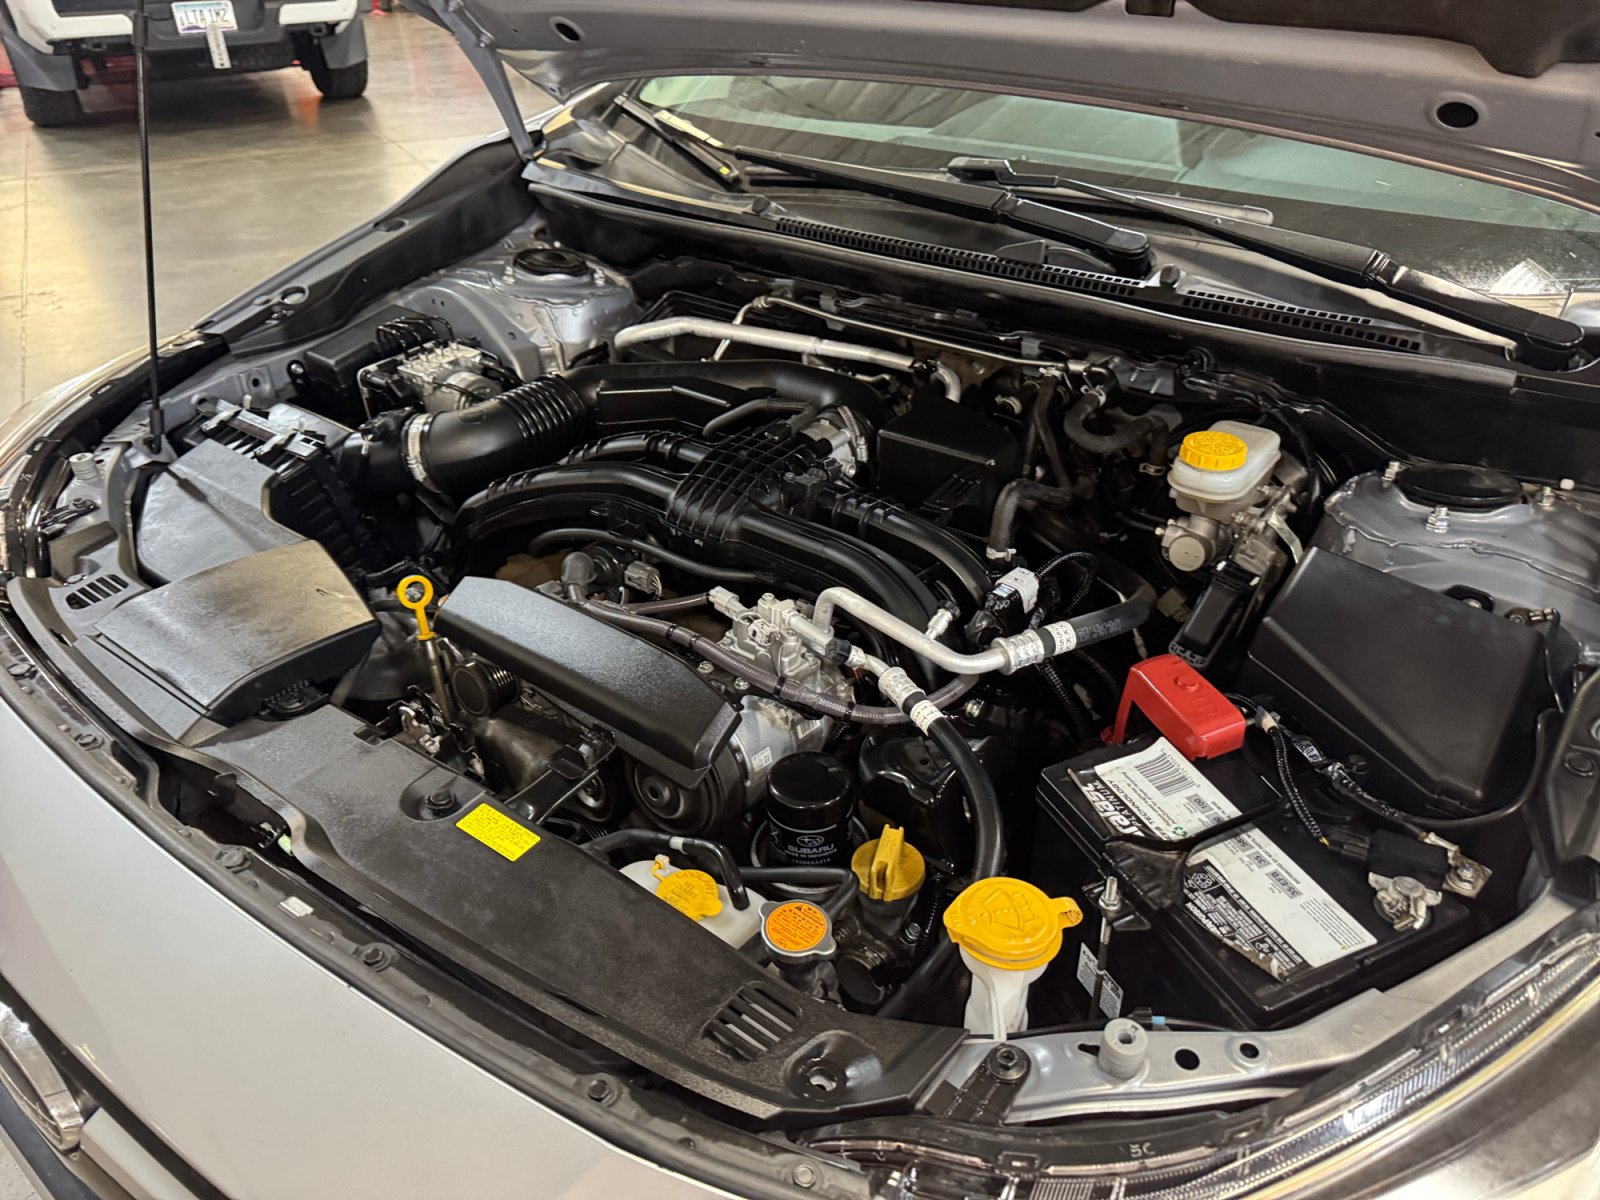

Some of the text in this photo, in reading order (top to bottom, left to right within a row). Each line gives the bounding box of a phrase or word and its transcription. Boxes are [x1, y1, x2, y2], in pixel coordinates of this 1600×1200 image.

[1082, 783, 1145, 837] ralast
[1093, 779, 1142, 827] PLATINUM
[1106, 778, 1155, 825] TECHNOLOGY
[1193, 797, 1208, 809] 100
[787, 843, 834, 854] SUBARU
[1270, 870, 1299, 897] 35-EFB
